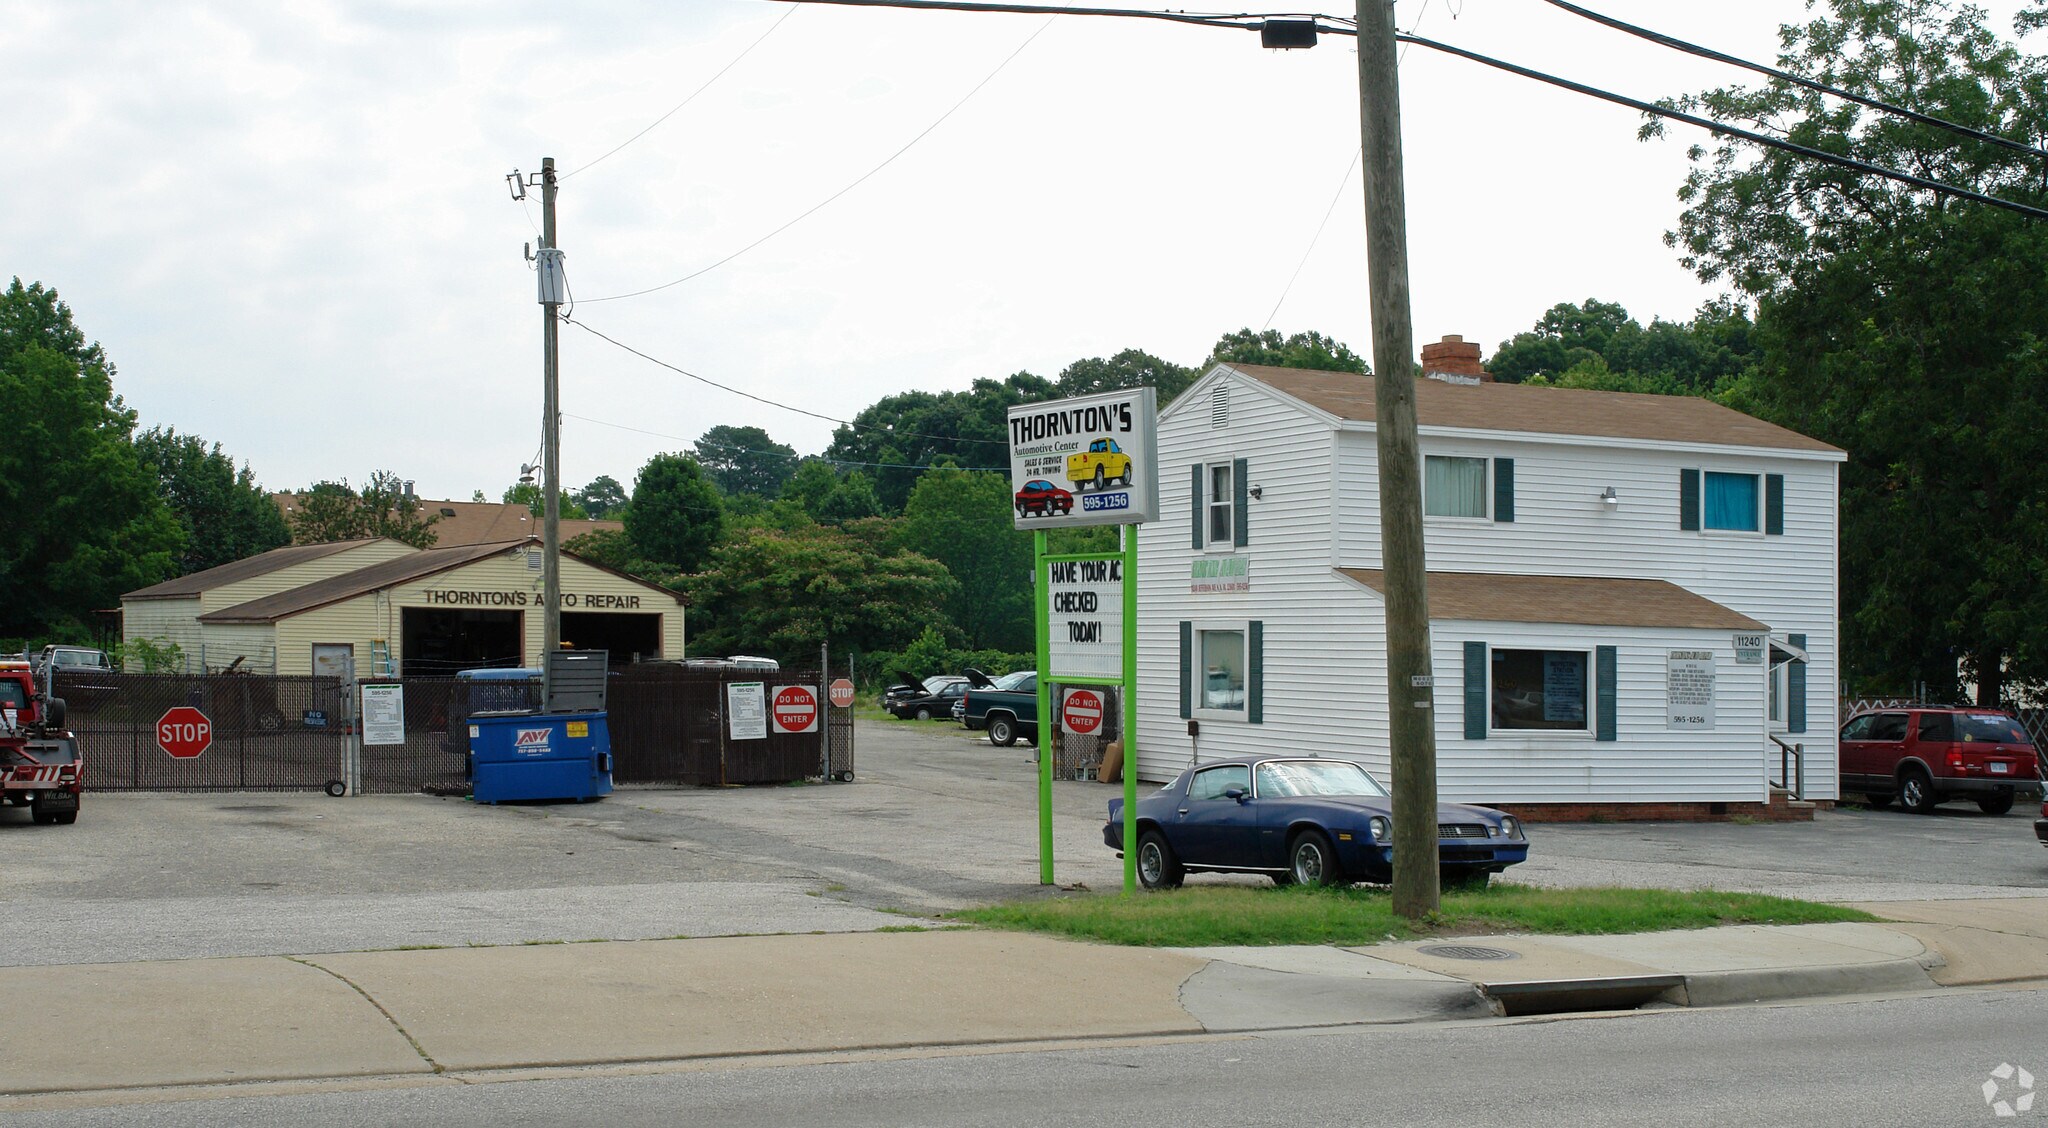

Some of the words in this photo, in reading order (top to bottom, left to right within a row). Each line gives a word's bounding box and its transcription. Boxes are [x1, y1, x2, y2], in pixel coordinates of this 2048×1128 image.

[1010, 402, 1131, 446] THORNTON'S
[1014, 443, 1053, 456] Automotive
[1055, 441, 1079, 451] Center
[1024, 458, 1038, 467] SALES
[1042, 456, 1062, 466] SERVICE
[1026, 469, 1032, 477] 24
[1042, 466, 1061, 475] TOWING
[1084, 494, 1127, 509] 595-1256
[1051, 562, 1077, 583] HAVE
[1080, 561, 1107, 582] YOUR
[1109, 560, 1122, 582] AC
[425, 589, 527, 606] THORNTON'S
[534, 593, 577, 607] ATO
[585, 595, 640, 609] REPAIR
[1054, 592, 1098, 613] CHECKED
[1068, 621, 1102, 643] TODAY!
[1737, 636, 1760, 647] 11240
[779, 695, 791, 703] DO
[794, 695, 810, 703] NOT
[831, 688, 854, 698] STOP
[1069, 697, 1081, 705] DO
[1083, 698, 1098, 707] NOT
[782, 715, 808, 723] ENTER
[1071, 717, 1094, 726] ENTER
[161, 723, 209, 744] STOP
